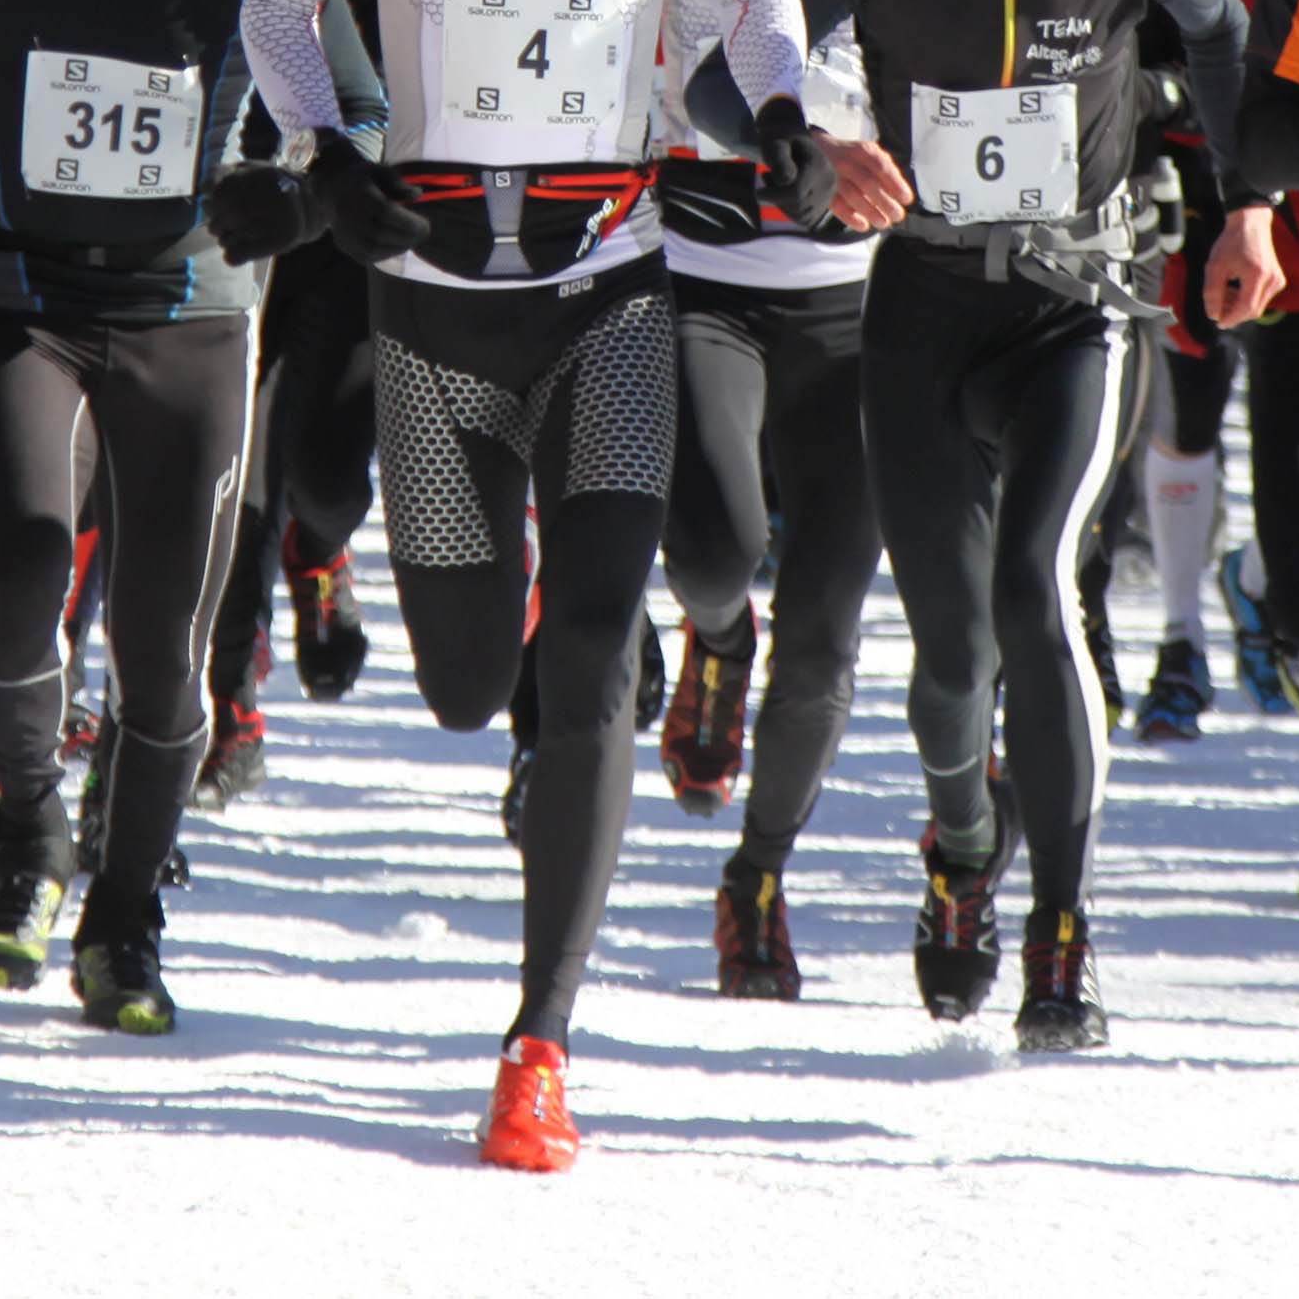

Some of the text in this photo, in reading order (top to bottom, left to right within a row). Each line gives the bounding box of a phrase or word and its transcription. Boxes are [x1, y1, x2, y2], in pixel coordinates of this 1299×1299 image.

[1037, 17, 1092, 39] TEAM
[516, 28, 550, 80] 4
[64, 100, 162, 156] 315
[975, 135, 1005, 182] 6
